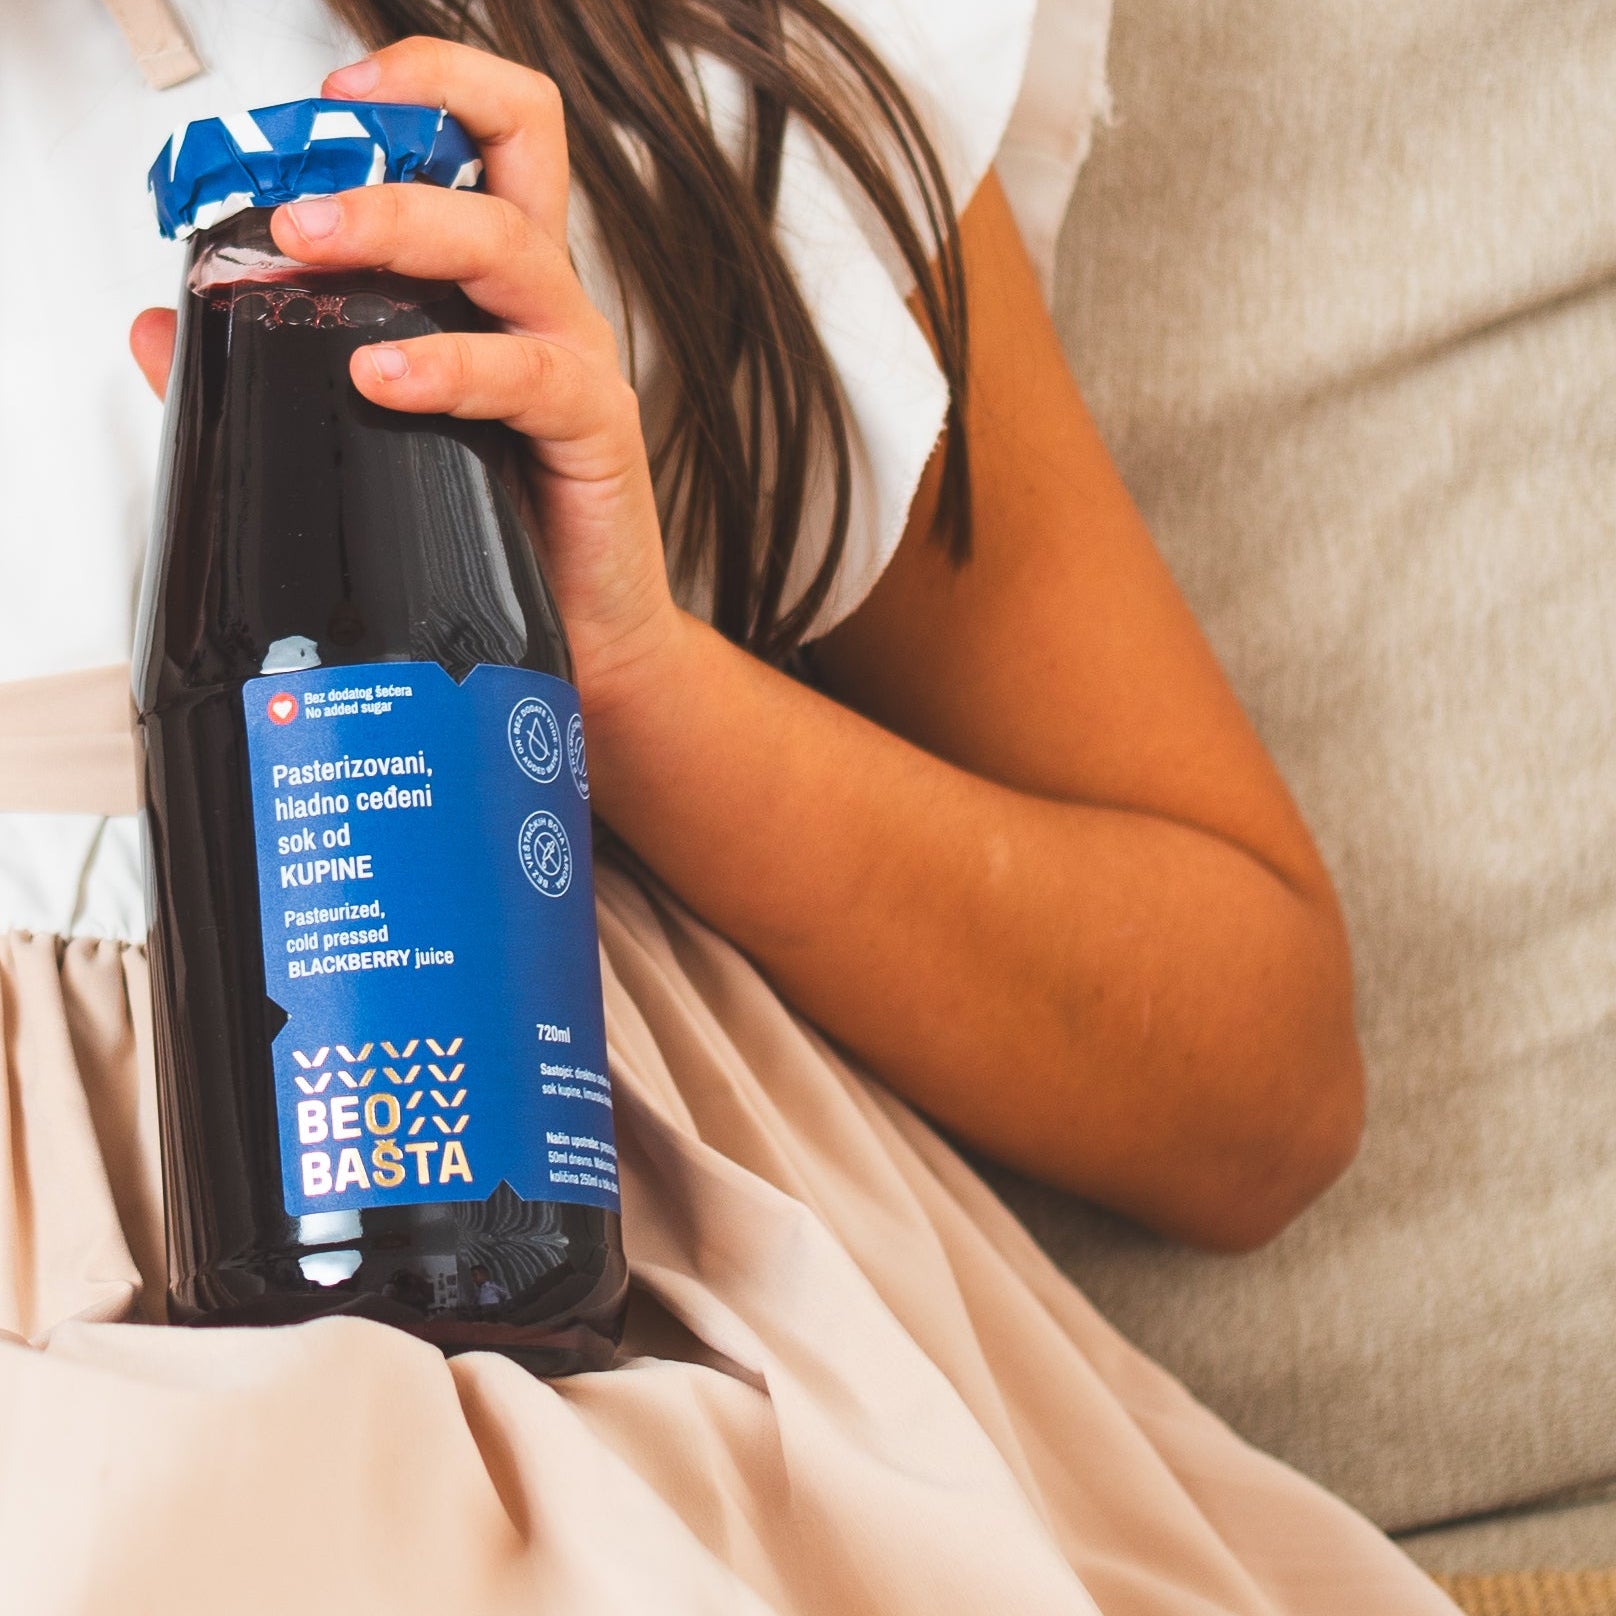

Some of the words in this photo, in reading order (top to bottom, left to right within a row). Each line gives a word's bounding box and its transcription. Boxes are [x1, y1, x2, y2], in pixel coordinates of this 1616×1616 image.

[304, 692, 326, 705] Bez
[328, 687, 373, 702] dodatog
[375, 684, 413, 698] šećera
[306, 707, 322, 719] No
[324, 702, 359, 717] added
[361, 701, 393, 715] sugar
[272, 750, 433, 788] Pasterizovani,
[275, 793, 350, 821] hladno
[356, 784, 433, 812] ceđeni
[277, 827, 317, 855] sok
[322, 823, 351, 849] od
[280, 854, 374, 889] KUPINE
[284, 899, 386, 928] Pasteurized,
[286, 931, 319, 954] cold
[323, 924, 389, 952] pressed
[288, 948, 412, 979] BLACKBERRY
[414, 947, 455, 970] juice
[536, 1023, 571, 1044] 720ml
[296, 1092, 401, 1145] BEO
[300, 1138, 474, 1198] BAŠTA
